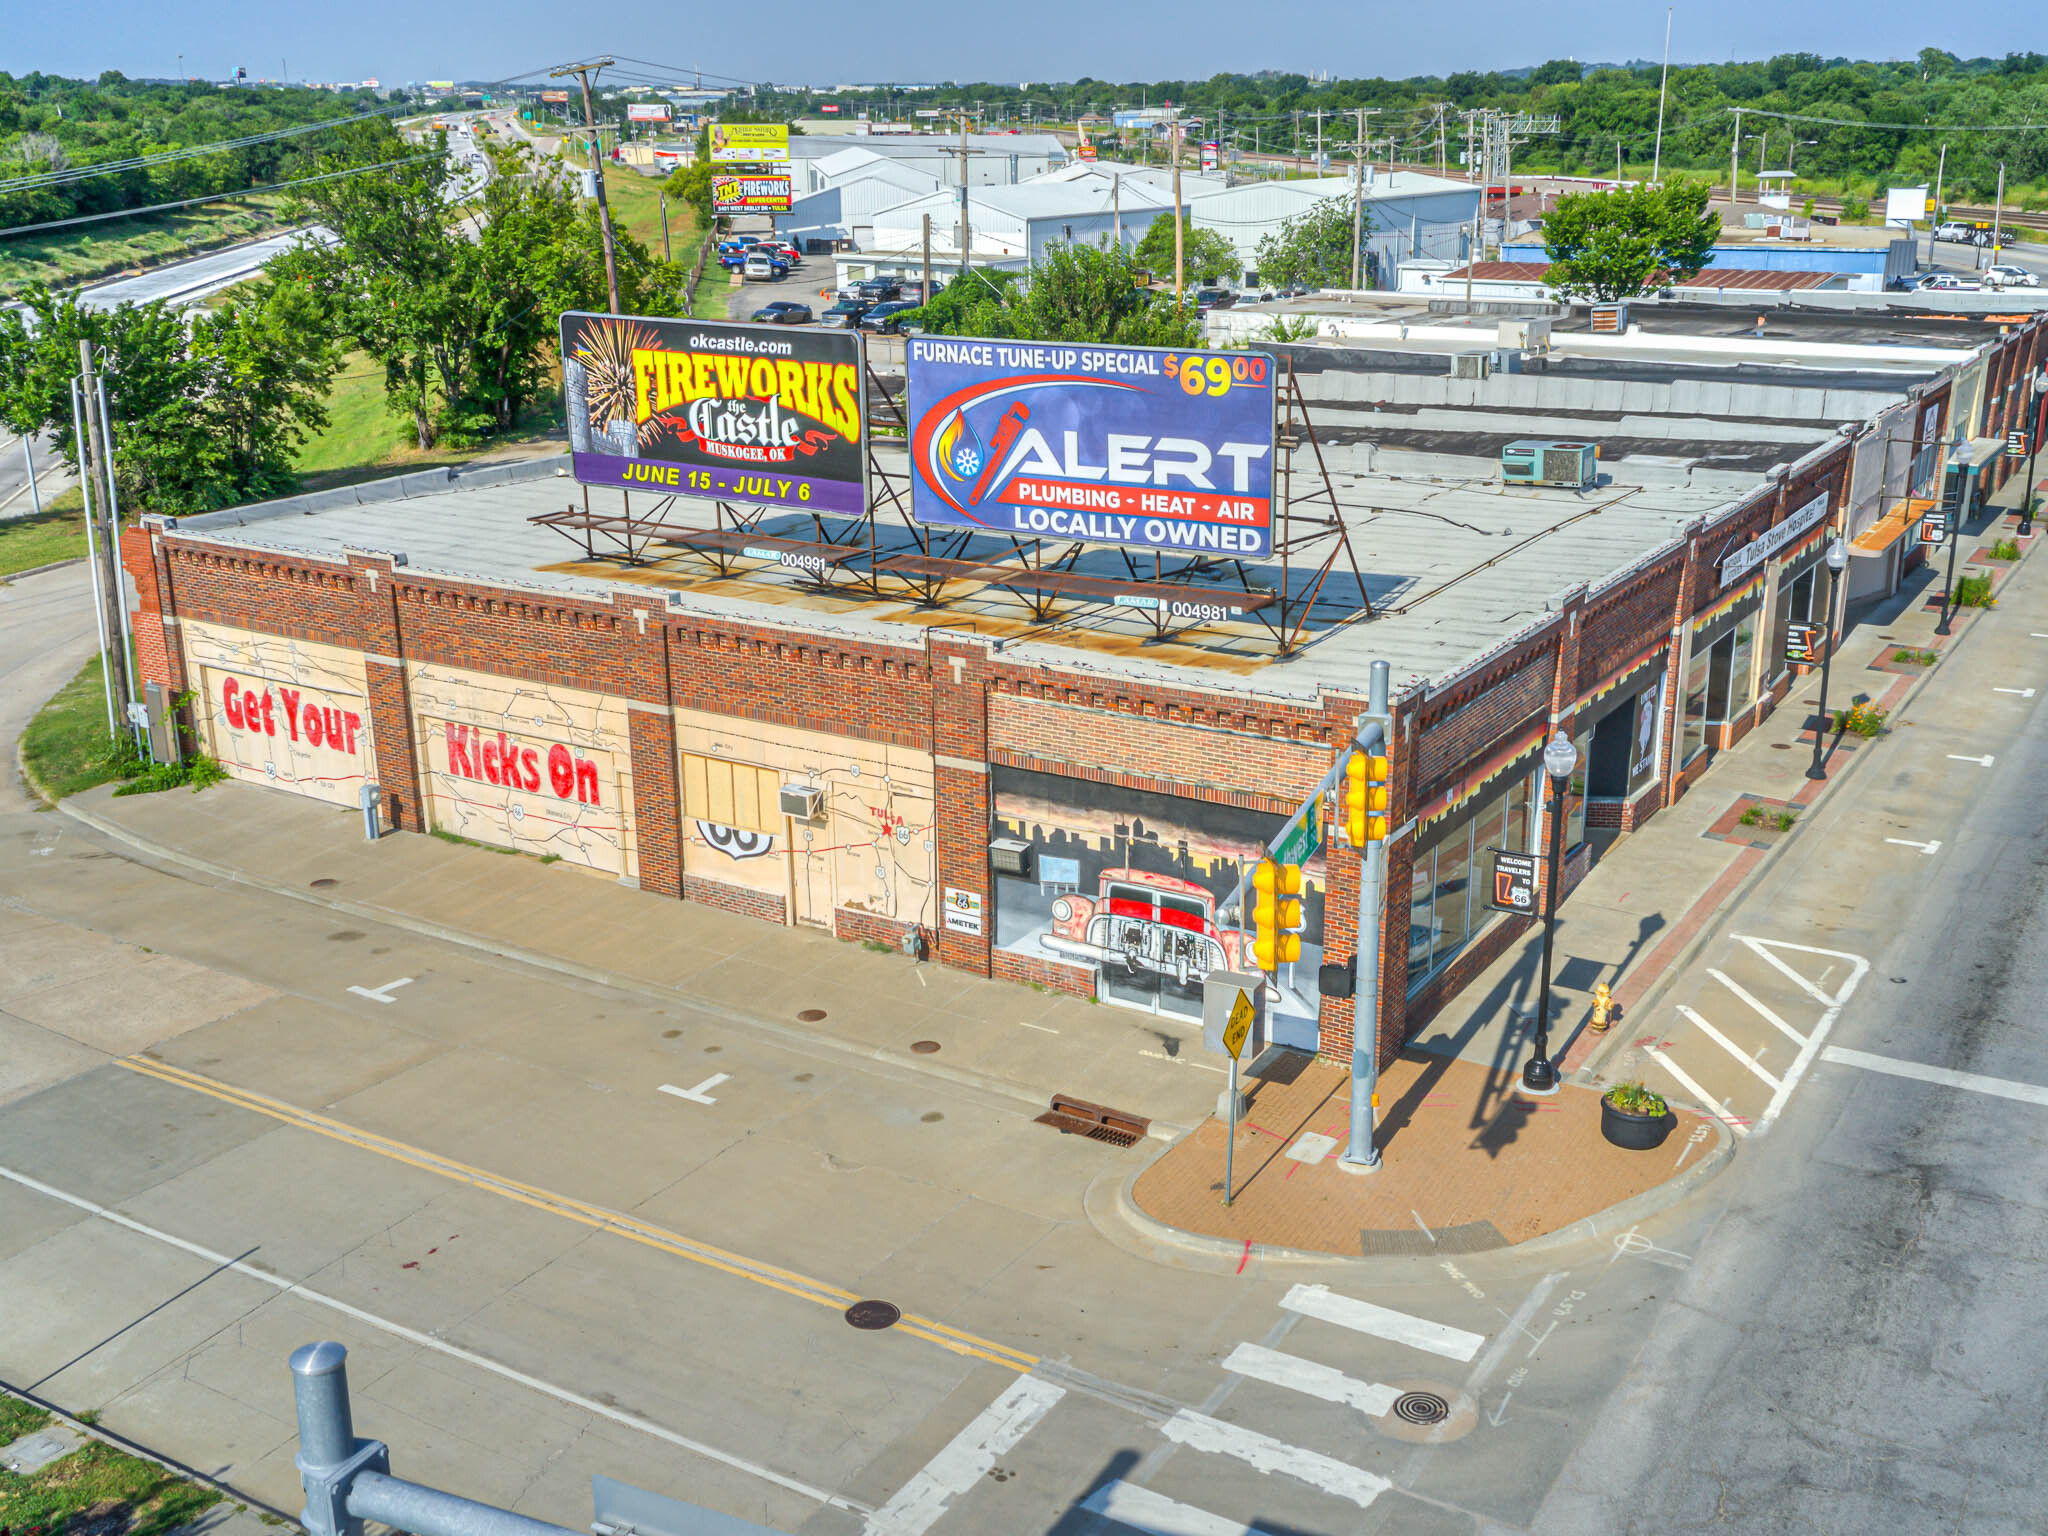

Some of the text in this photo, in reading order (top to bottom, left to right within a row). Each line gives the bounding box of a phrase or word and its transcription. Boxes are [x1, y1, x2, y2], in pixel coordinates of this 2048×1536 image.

[718, 181, 738, 197] TNT
[744, 180, 790, 196] FIREWORKS
[689, 333, 792, 356] okcastle.com
[913, 342, 1159, 375] FURNACE TUNE-UP SPECIAL
[632, 347, 861, 444] FIREWORKS
[727, 400, 747, 414] the
[689, 393, 800, 446] Castle
[706, 440, 786, 462] MUSKOGEE, OK
[984, 428, 1270, 501] ALERT
[622, 463, 680, 485] JUNE
[687, 471, 711, 490] 15
[733, 476, 792, 499] JULY
[798, 482, 811, 501] 6
[1019, 483, 1255, 521] PLUMBING HEAT AIR
[1014, 507, 1262, 552] LOCALLY OWNED
[1746, 541, 1765, 564] Tulsa
[1766, 527, 1786, 550] Stove
[781, 553, 825, 571] 004991
[1172, 602, 1227, 621] 004981
[223, 676, 361, 755] Get Your
[445, 723, 600, 806] Kicks On
[869, 806, 904, 826] TULSA
[900, 830, 909, 840] 66
[1496, 865, 1531, 876] TRAVELERS
[1500, 856, 1532, 868] WELCOME
[957, 898, 968, 908] 66
[1514, 894, 1527, 904] 66
[946, 917, 979, 931] AMETEK
[1230, 1006, 1248, 1029] DEAD
[1232, 1025, 1245, 1045] END
